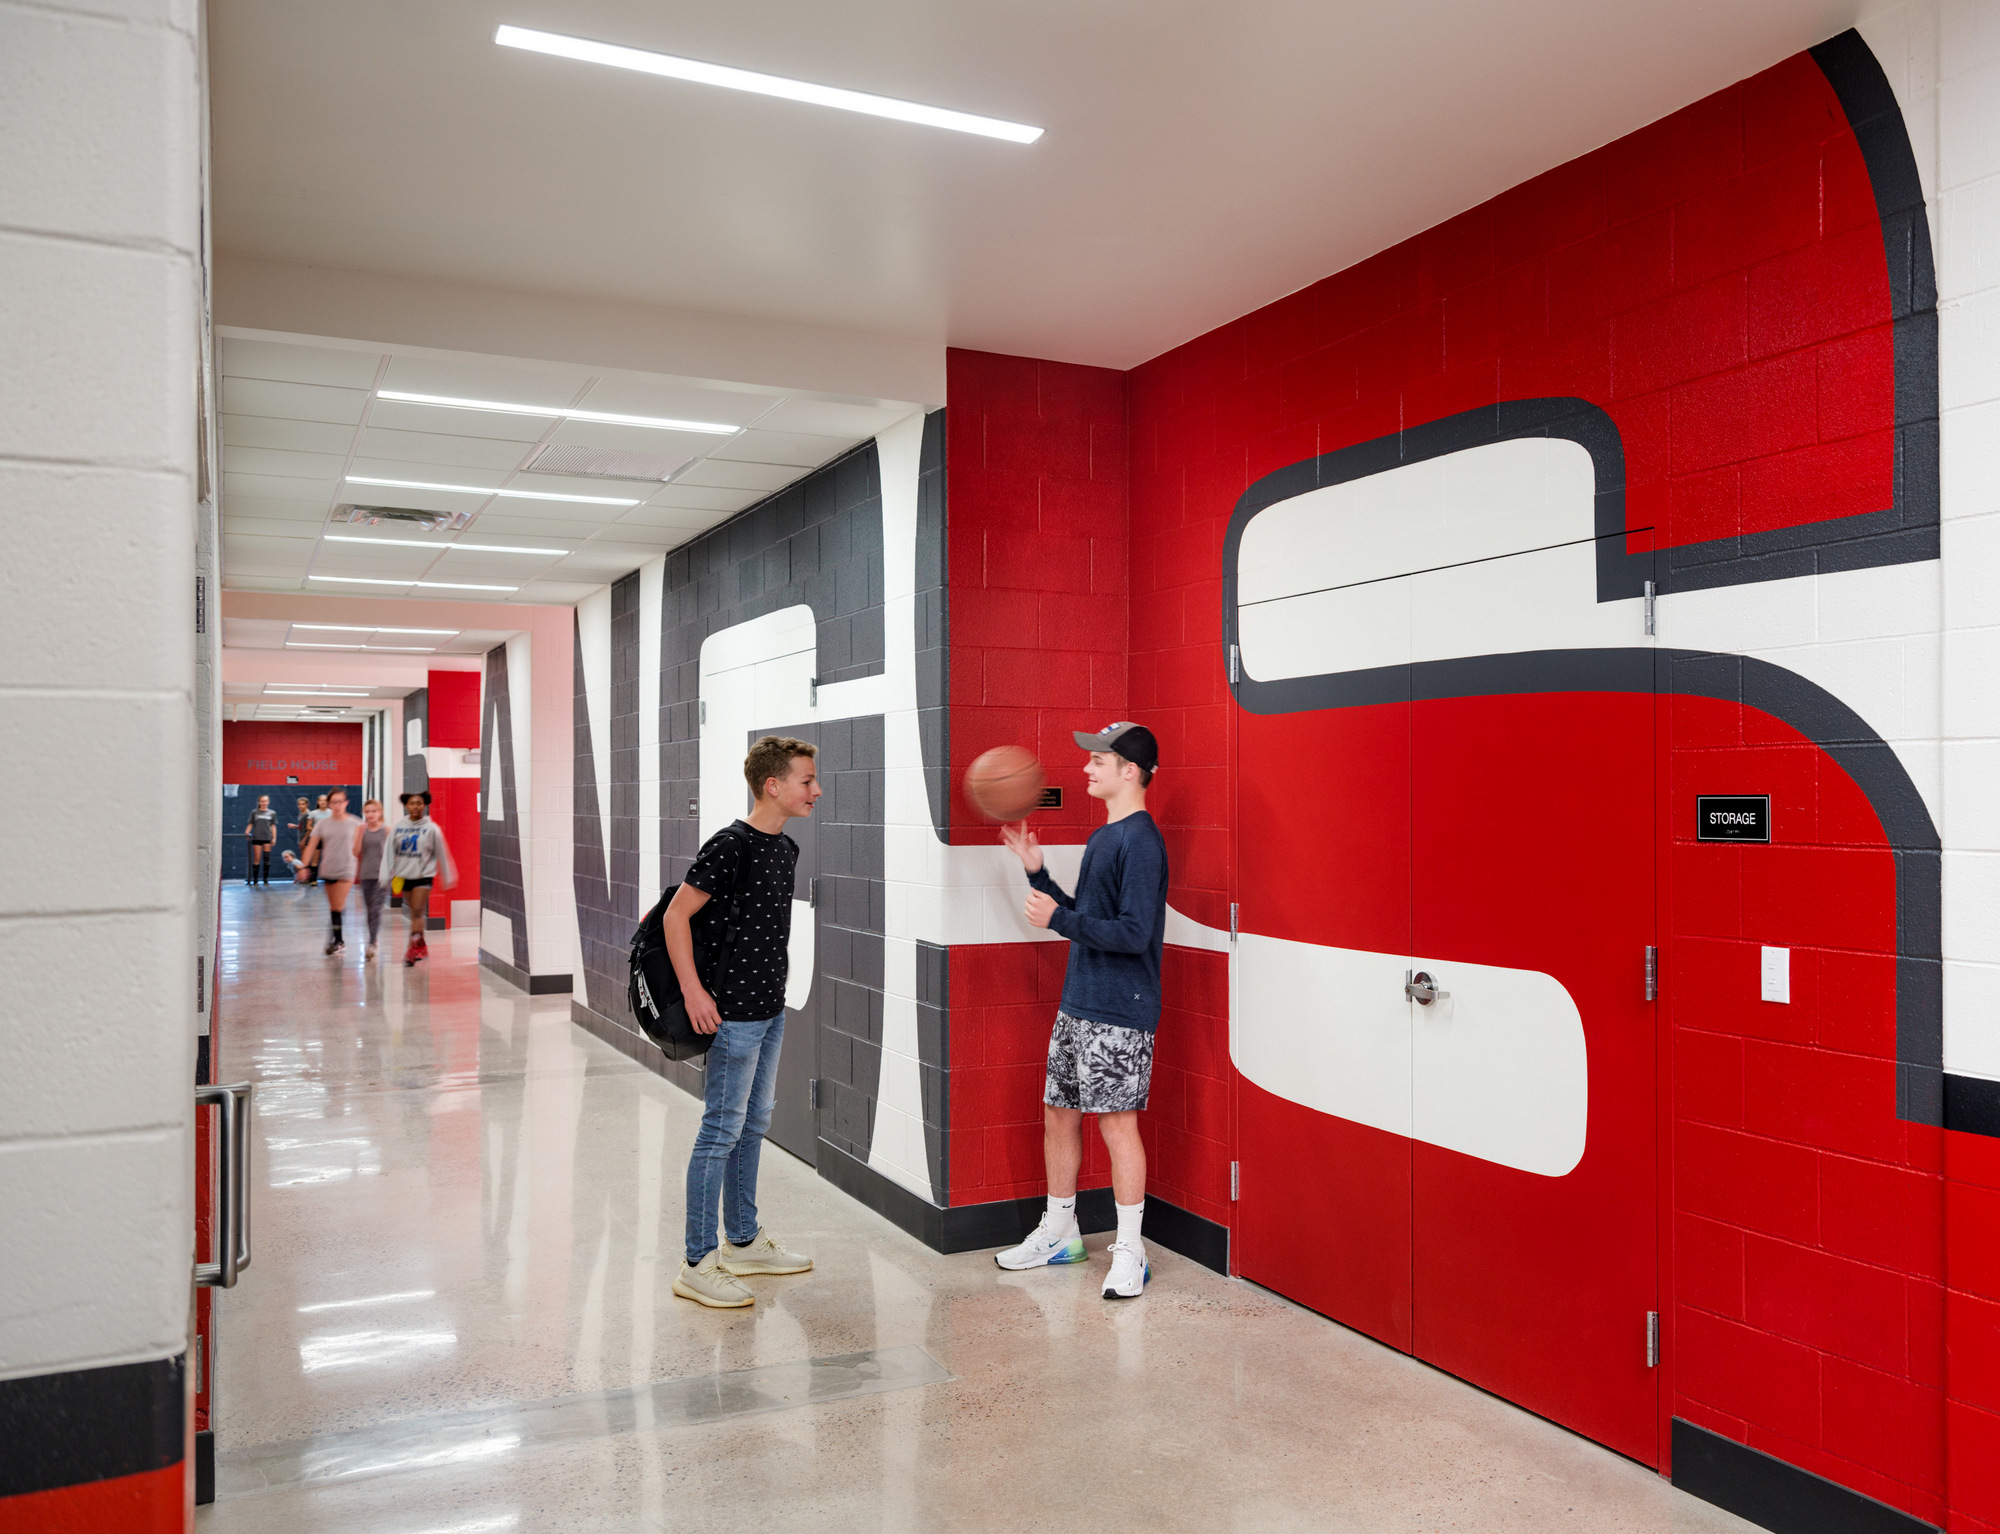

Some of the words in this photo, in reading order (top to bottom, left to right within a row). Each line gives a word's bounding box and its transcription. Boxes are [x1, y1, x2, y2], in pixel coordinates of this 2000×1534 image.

[247, 759, 287, 770] FIELD
[290, 759, 338, 771] HOUSE
[1709, 812, 1756, 825] STORAGE
